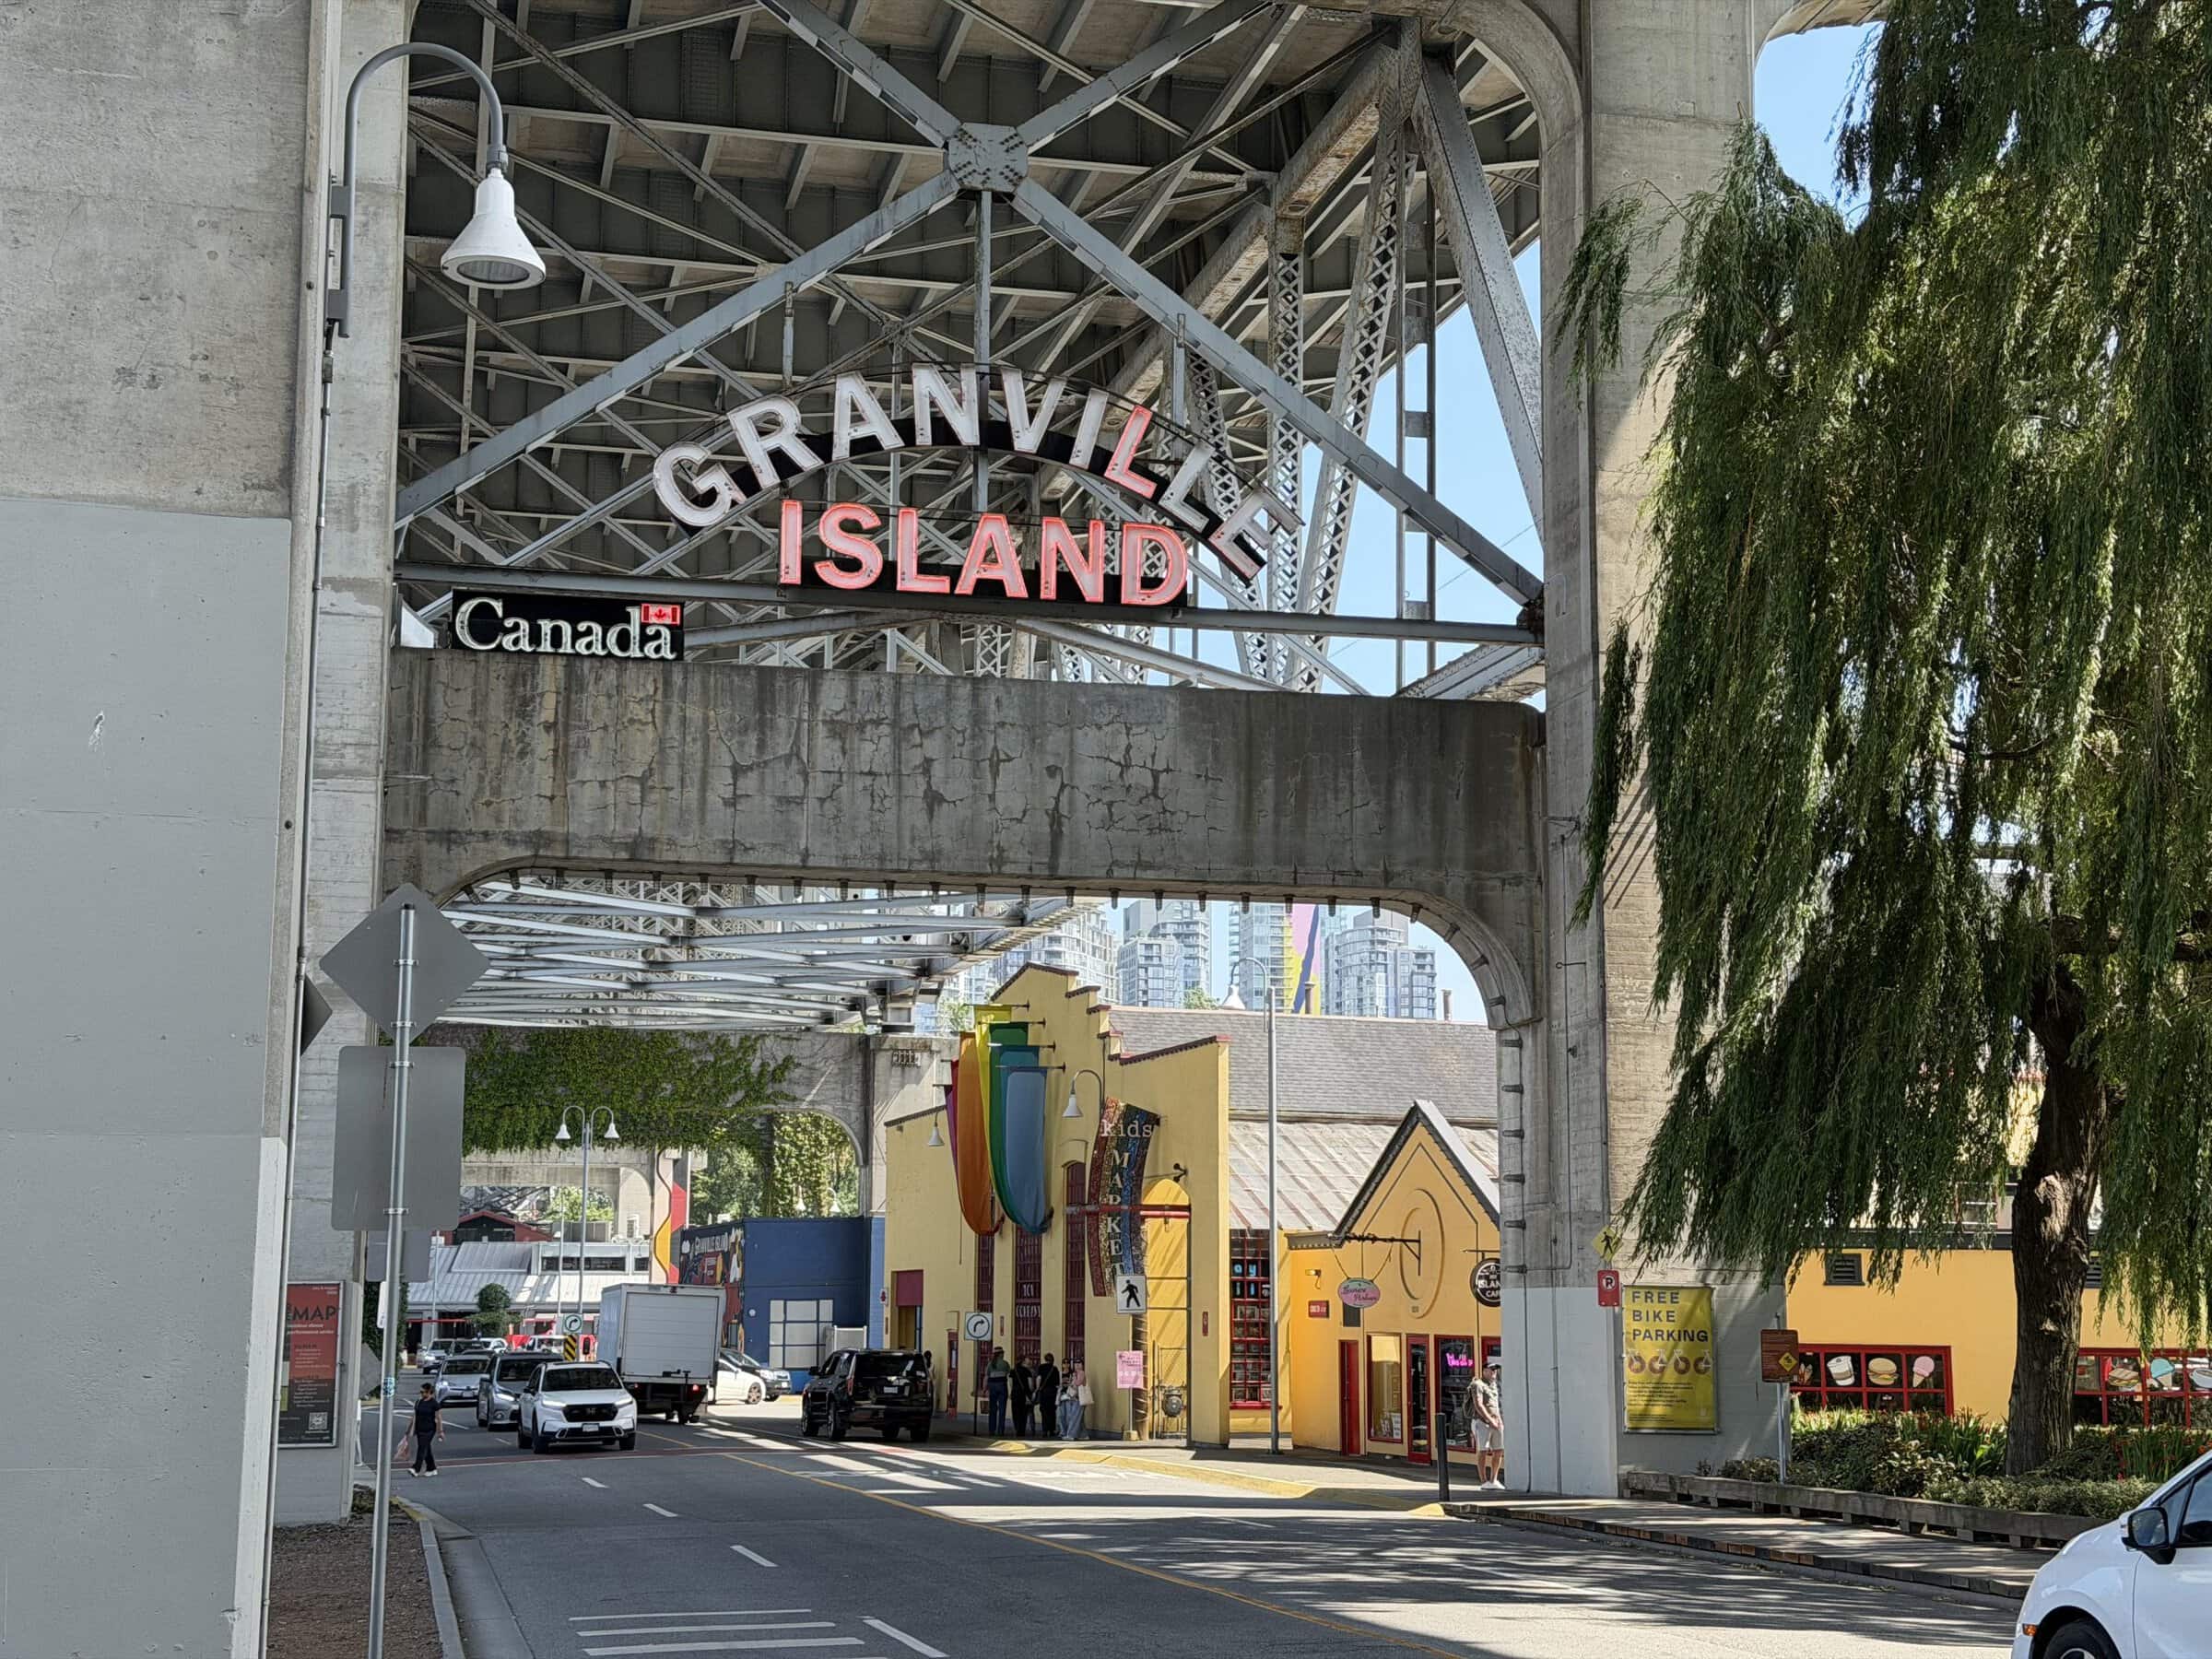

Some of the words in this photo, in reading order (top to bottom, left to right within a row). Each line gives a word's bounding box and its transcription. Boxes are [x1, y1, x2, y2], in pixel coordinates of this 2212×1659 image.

[653, 362, 1300, 581] GRANVILLE
[779, 499, 1188, 606] ISLAND
[454, 596, 677, 660] Canada
[1100, 1119, 1153, 1138] kids
[1477, 1279, 1500, 1288] ISLAN
[1631, 1290, 1681, 1304] FREE
[292, 1305, 336, 1321] MAP
[1632, 1310, 1677, 1323] BIKE
[1632, 1329, 1709, 1343] PARKING
